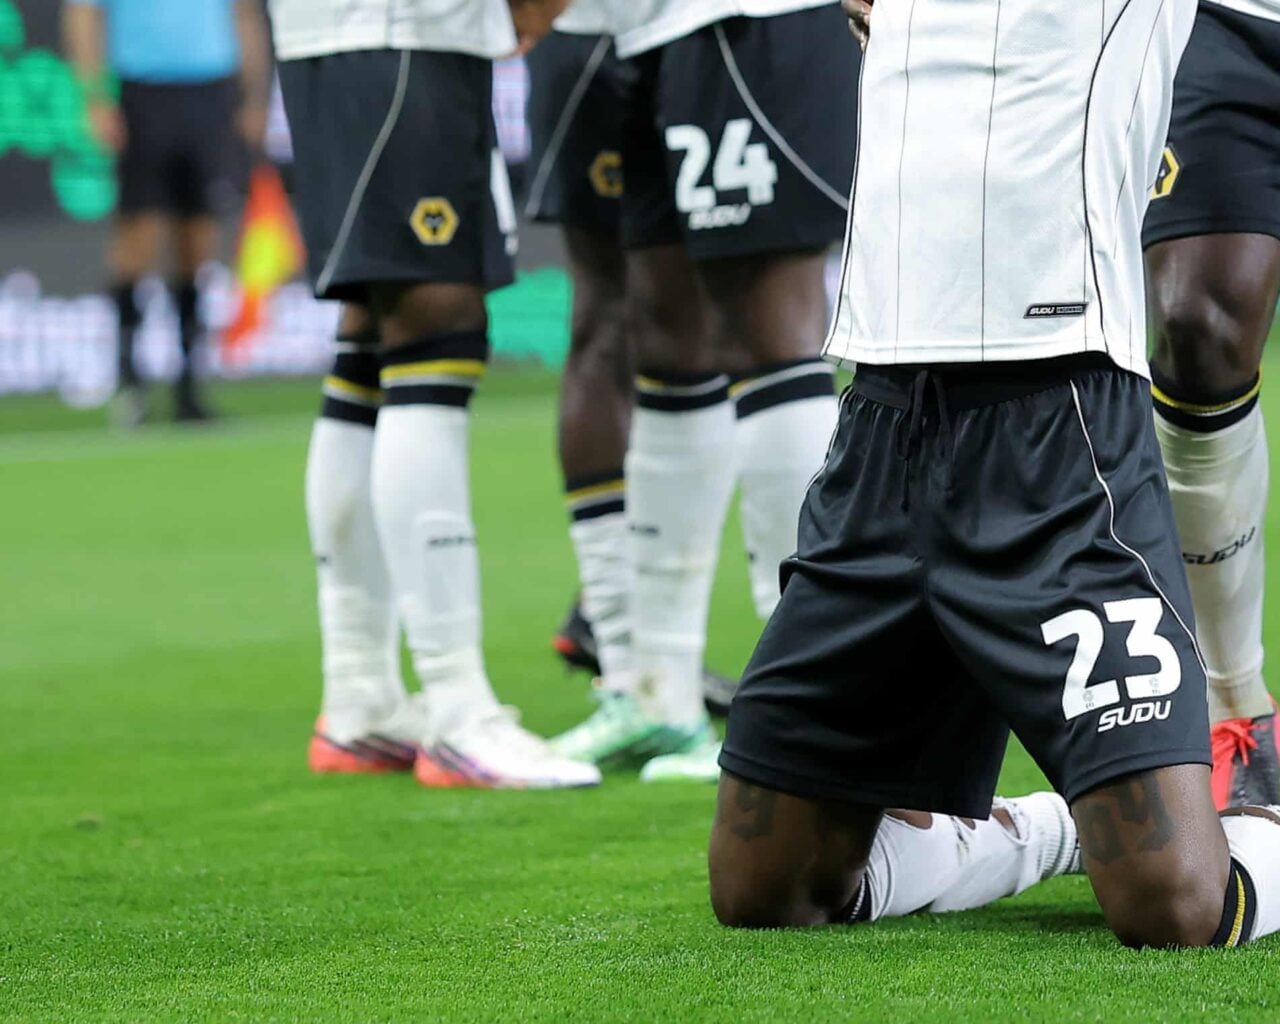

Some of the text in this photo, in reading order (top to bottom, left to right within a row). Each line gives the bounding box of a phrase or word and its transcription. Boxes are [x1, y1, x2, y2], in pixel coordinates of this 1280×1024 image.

[665, 117, 778, 213] 24
[1040, 597, 1182, 721] 23
[1097, 699, 1172, 733] SUDU
